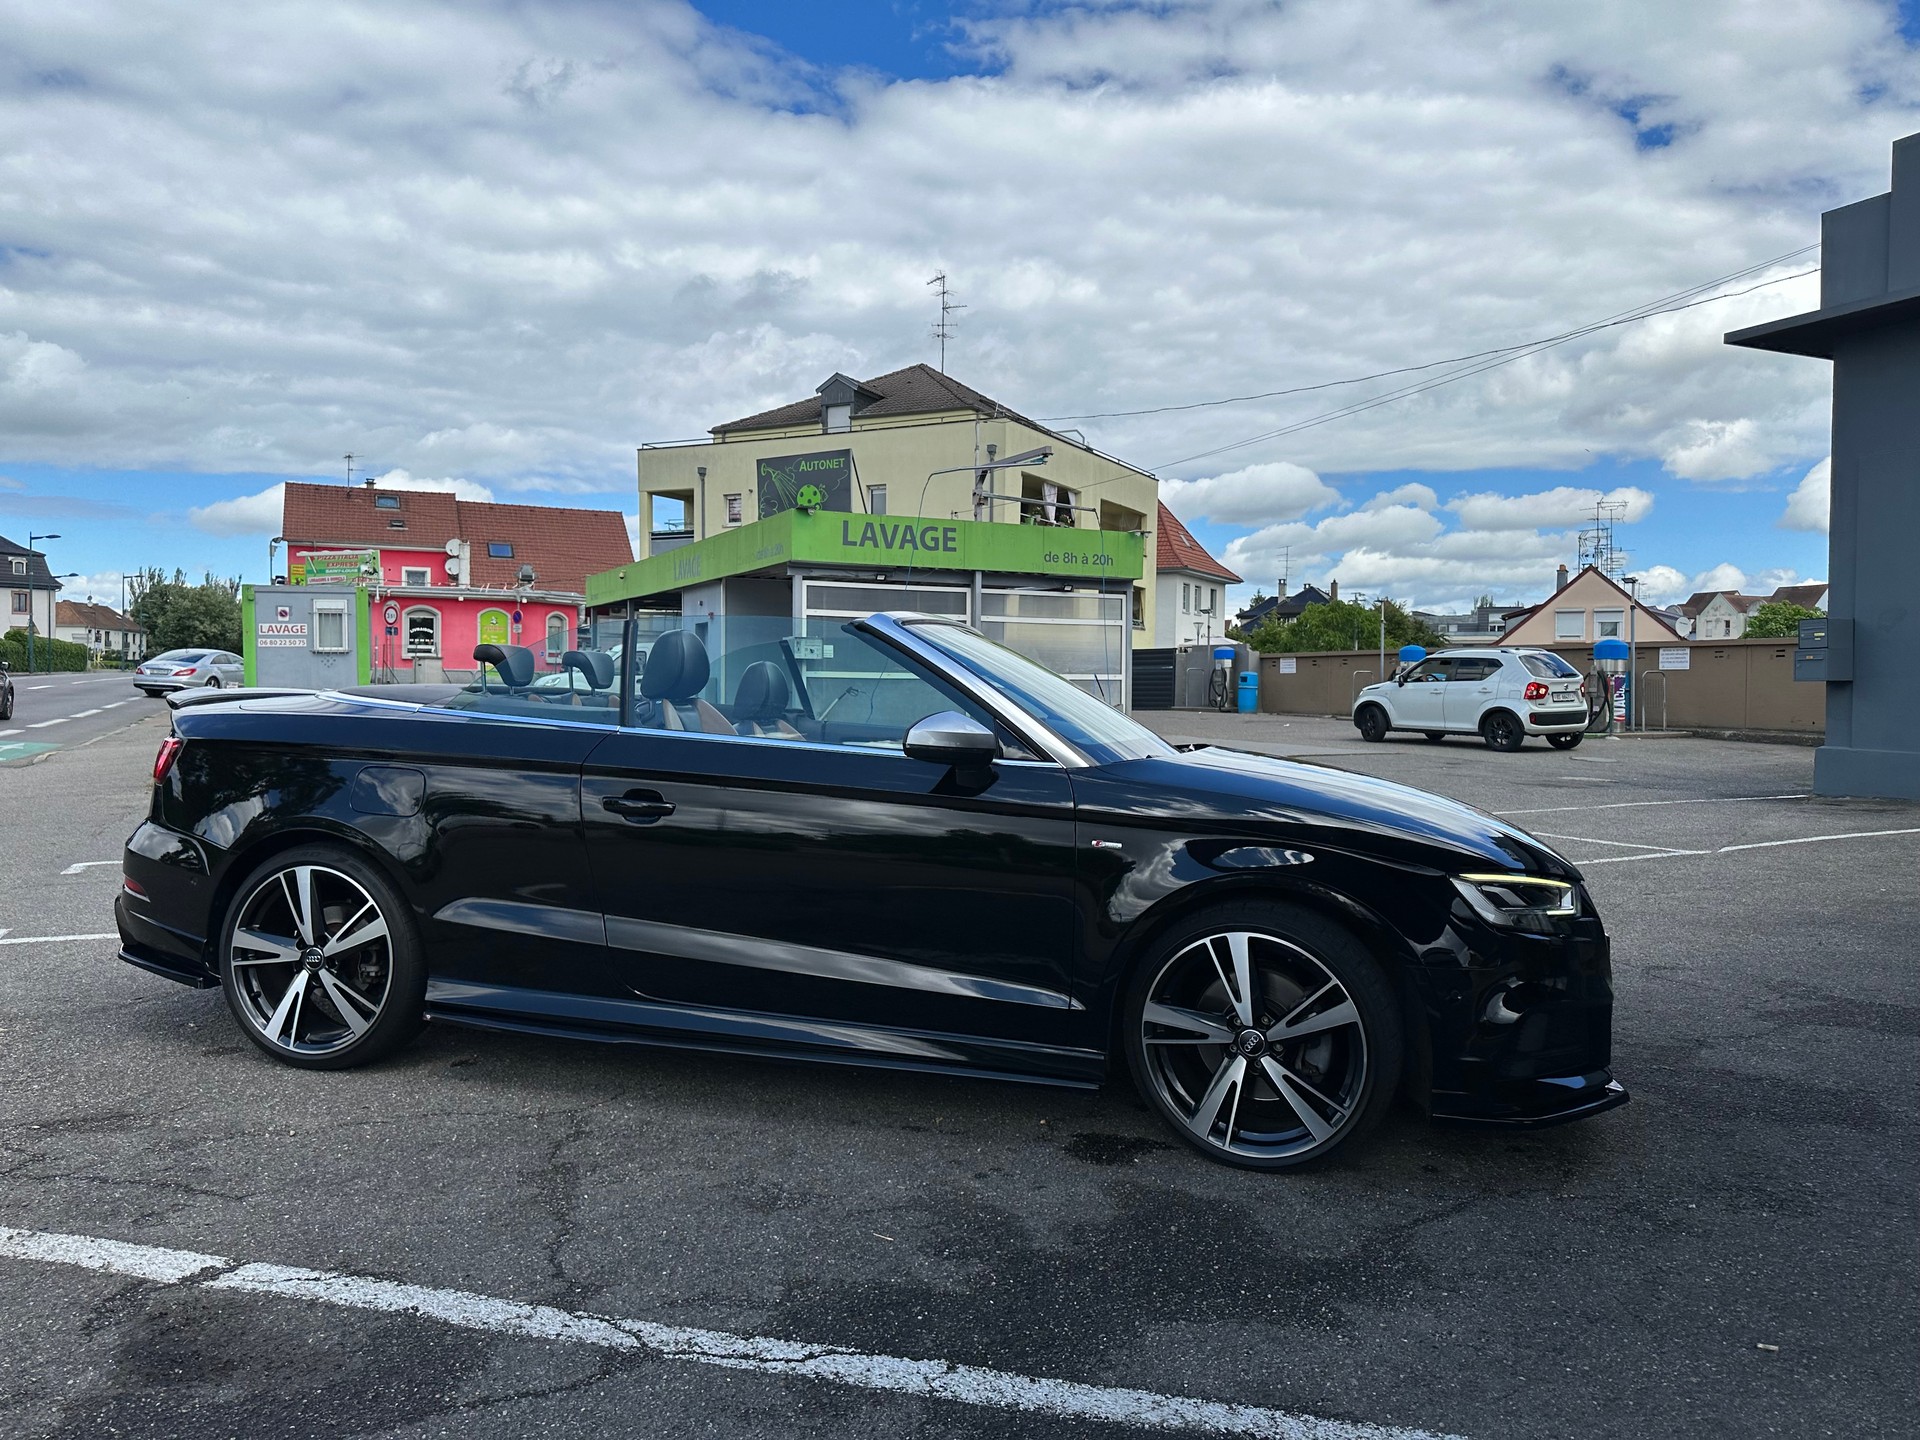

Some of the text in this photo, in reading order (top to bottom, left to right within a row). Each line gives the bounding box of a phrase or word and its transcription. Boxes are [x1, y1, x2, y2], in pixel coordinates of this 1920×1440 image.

[799, 458, 845, 472] AUTONET
[842, 520, 957, 552] LAVAGE
[1044, 551, 1114, 567] de 8h à 20h
[673, 554, 702, 581] LAVAGE
[260, 625, 307, 634] LAVAGE
